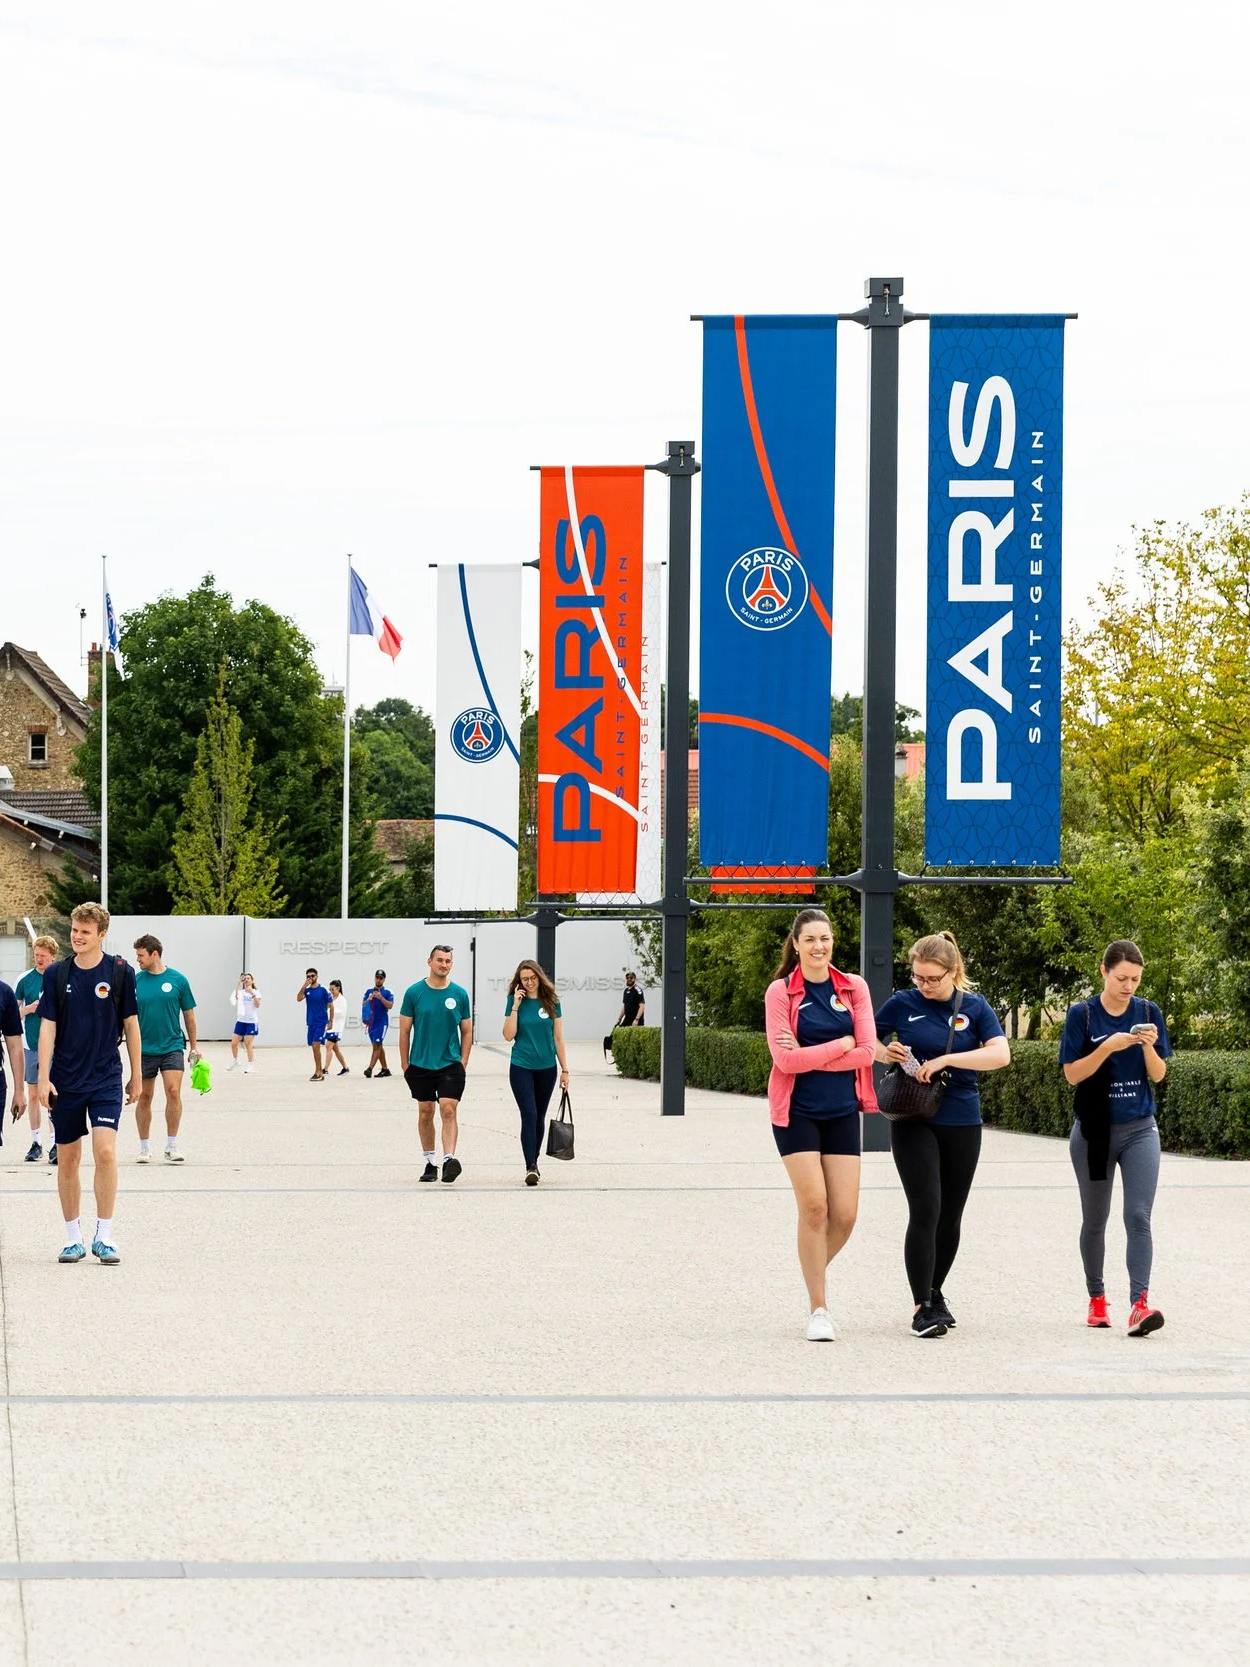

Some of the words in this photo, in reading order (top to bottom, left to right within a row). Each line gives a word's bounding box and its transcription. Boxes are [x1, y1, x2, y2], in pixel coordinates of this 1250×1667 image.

[740, 551, 795, 572] PARIS
[946, 375, 1016, 800] PARIS
[1028, 431, 1044, 744] SAINT-GERMAIN
[461, 711, 496, 725] PARIS
[553, 514, 607, 842] PARIS
[616, 557, 628, 798] SAINT-GERMAIN
[640, 636, 649, 833] SAINT-GERMAIN
[279, 940, 390, 956] RESPECT
